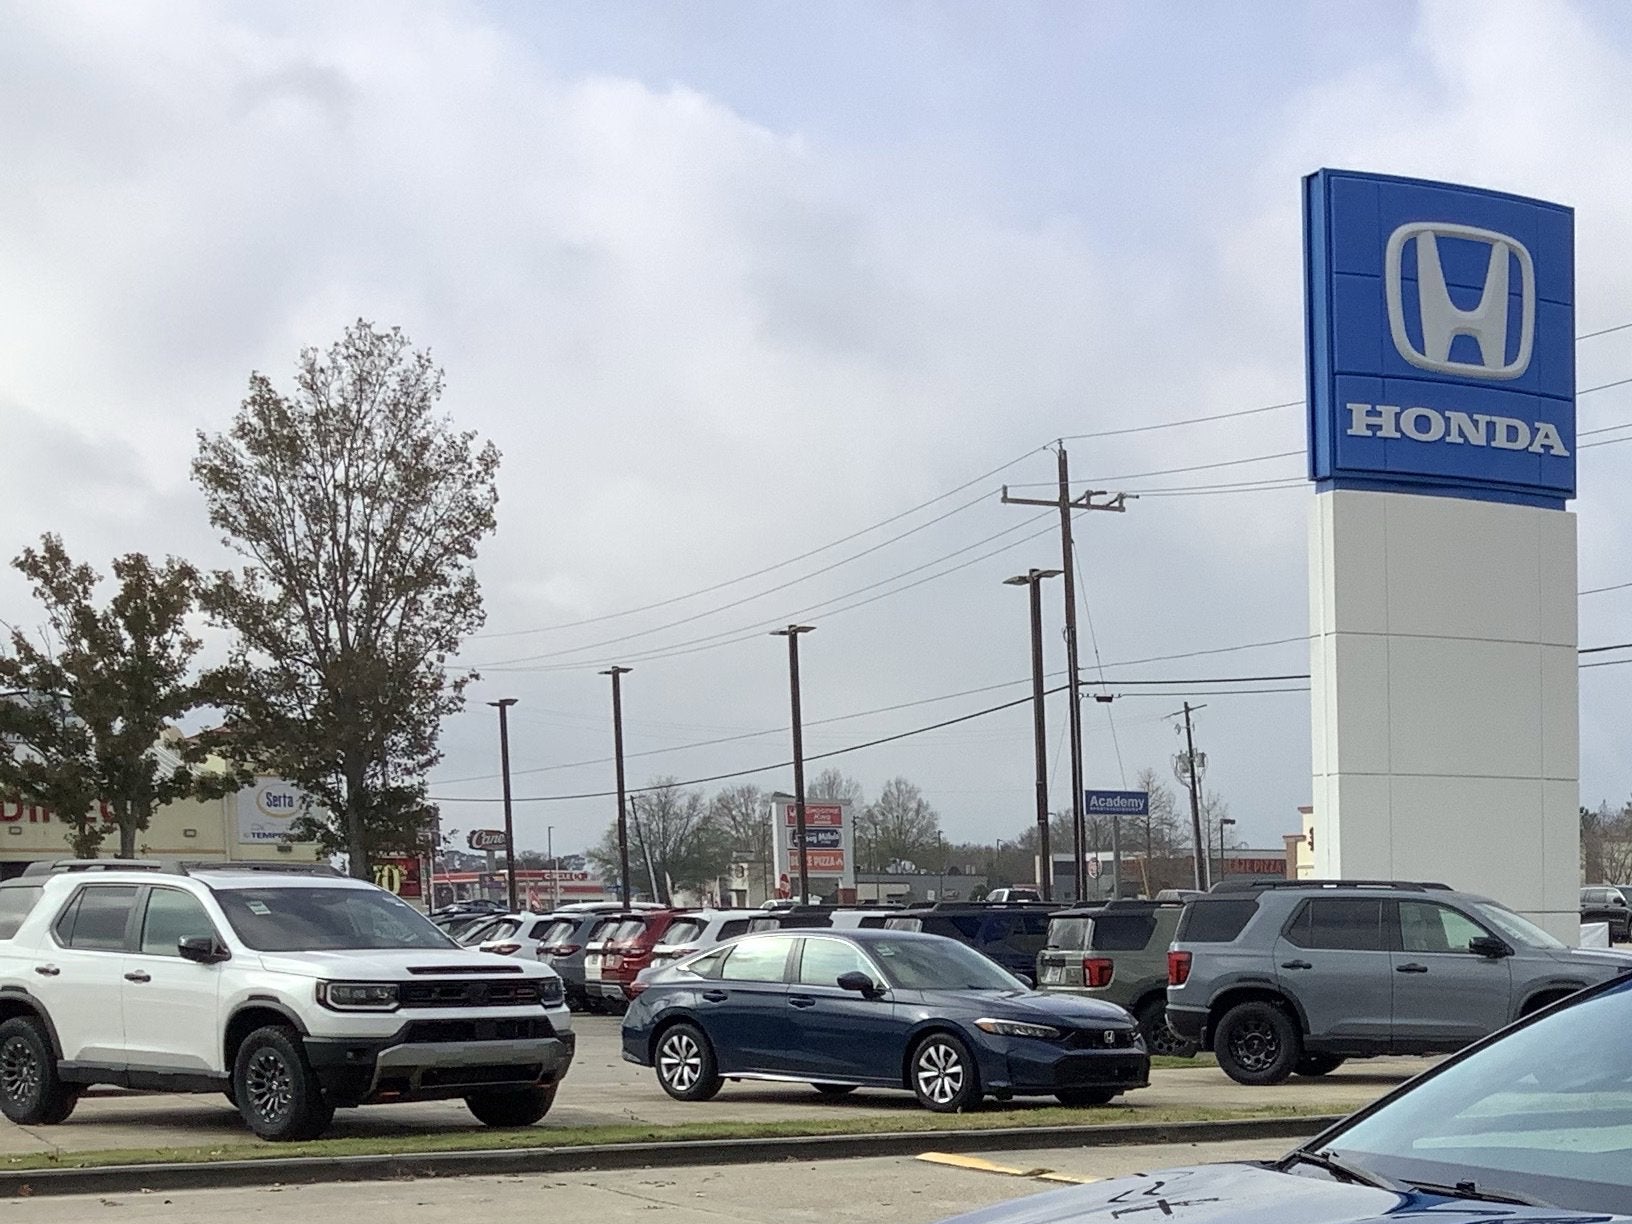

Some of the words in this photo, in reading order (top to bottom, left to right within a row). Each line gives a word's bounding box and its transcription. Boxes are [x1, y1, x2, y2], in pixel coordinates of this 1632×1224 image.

[1346, 403, 1570, 457] HONDA
[266, 792, 294, 808] Serta
[1090, 795, 1145, 811] Academy
[814, 856, 835, 867] PIZZA
